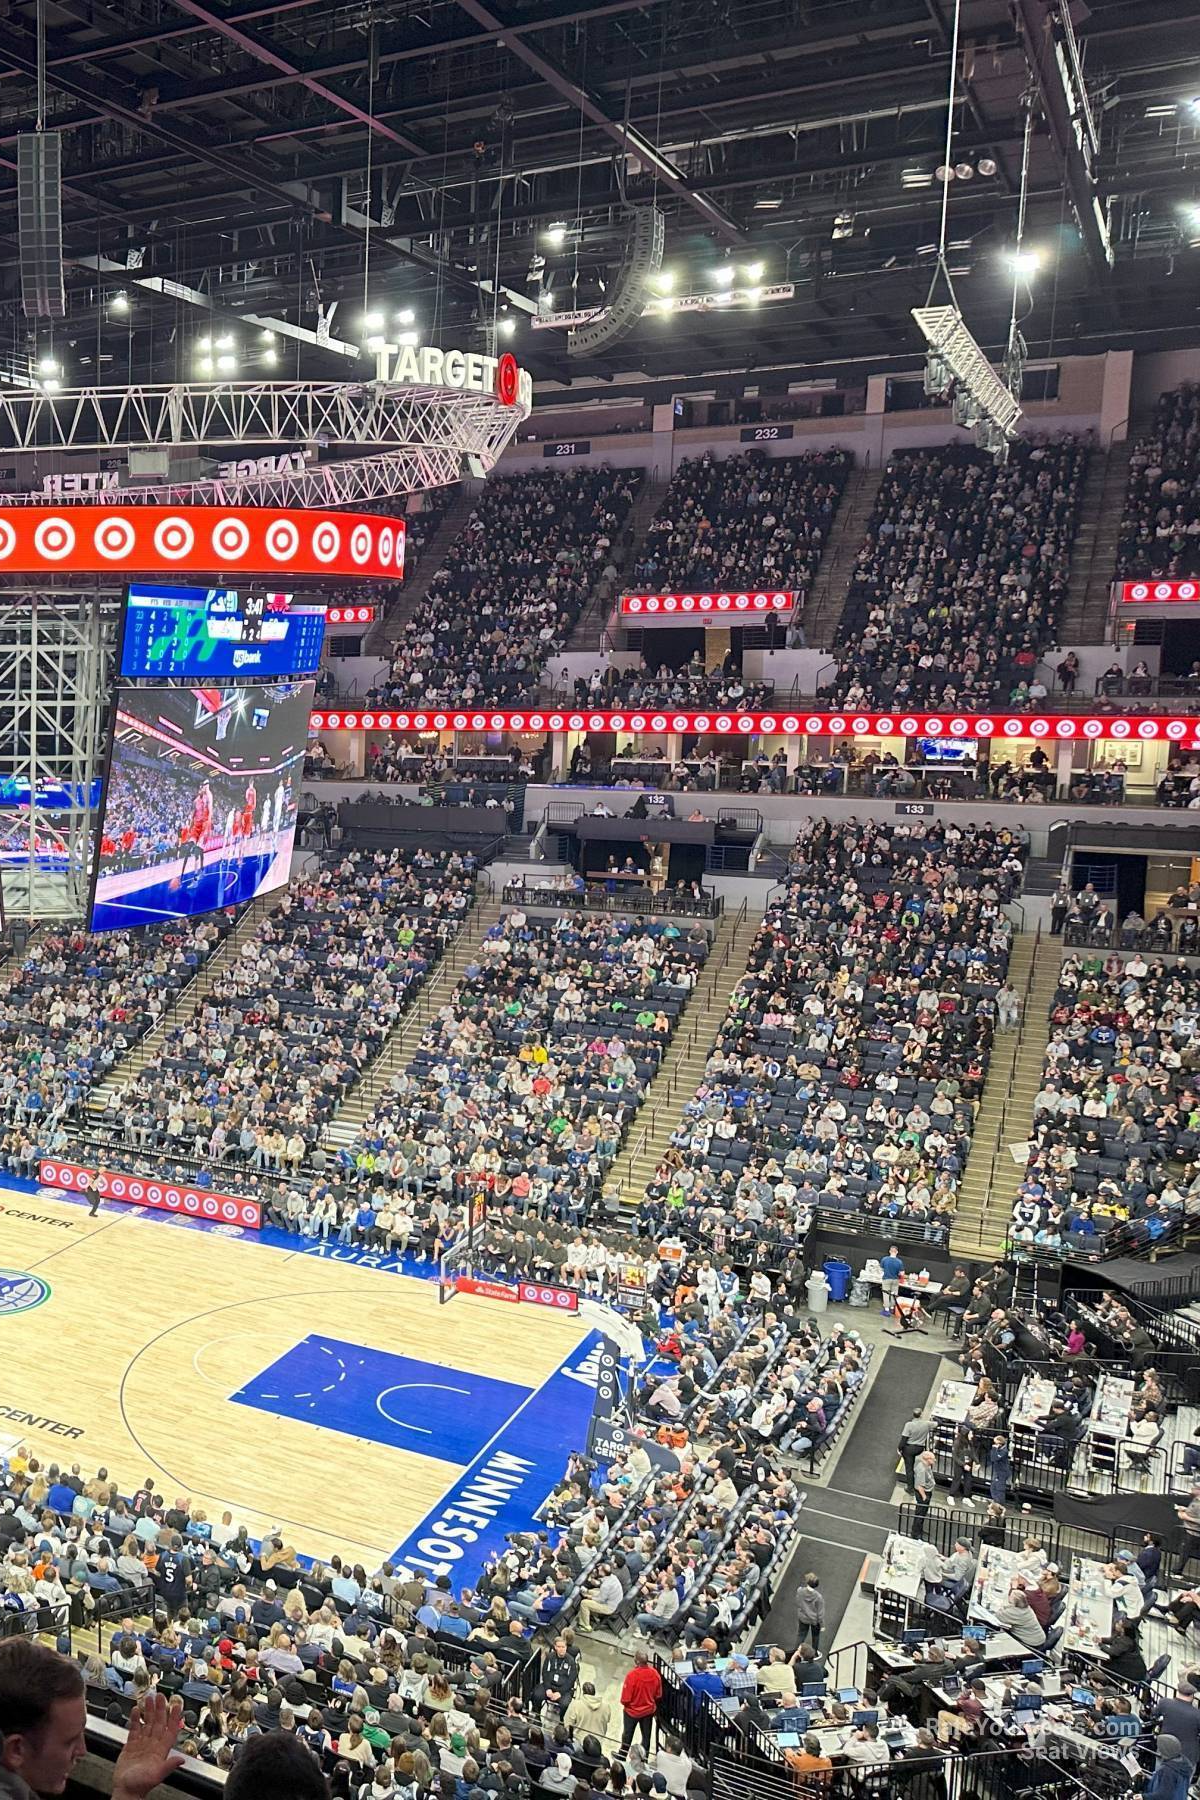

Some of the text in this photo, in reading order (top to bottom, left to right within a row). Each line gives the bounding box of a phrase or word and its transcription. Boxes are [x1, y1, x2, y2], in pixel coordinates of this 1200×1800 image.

[370, 343, 499, 393] TARGET
[755, 427, 779, 440] 232
[556, 444, 575, 455] 231
[246, 598, 263, 615] 3:41
[136, 611, 144, 619] 23
[150, 611, 156, 620] 4
[163, 611, 168, 620] 2
[135, 624, 166, 633] 27 5 4
[249, 629, 254, 641] 2
[172, 637, 177, 646] 3
[146, 649, 151, 658] 3
[145, 662, 150, 671] 4
[169, 662, 174, 671] 2
[648, 796, 665, 804] 132
[905, 805, 923, 814] 133
[5, 1210, 74, 1228] CENTER
[596, 1438, 631, 1453] TARGE
[166, 1569, 175, 1583] 5
